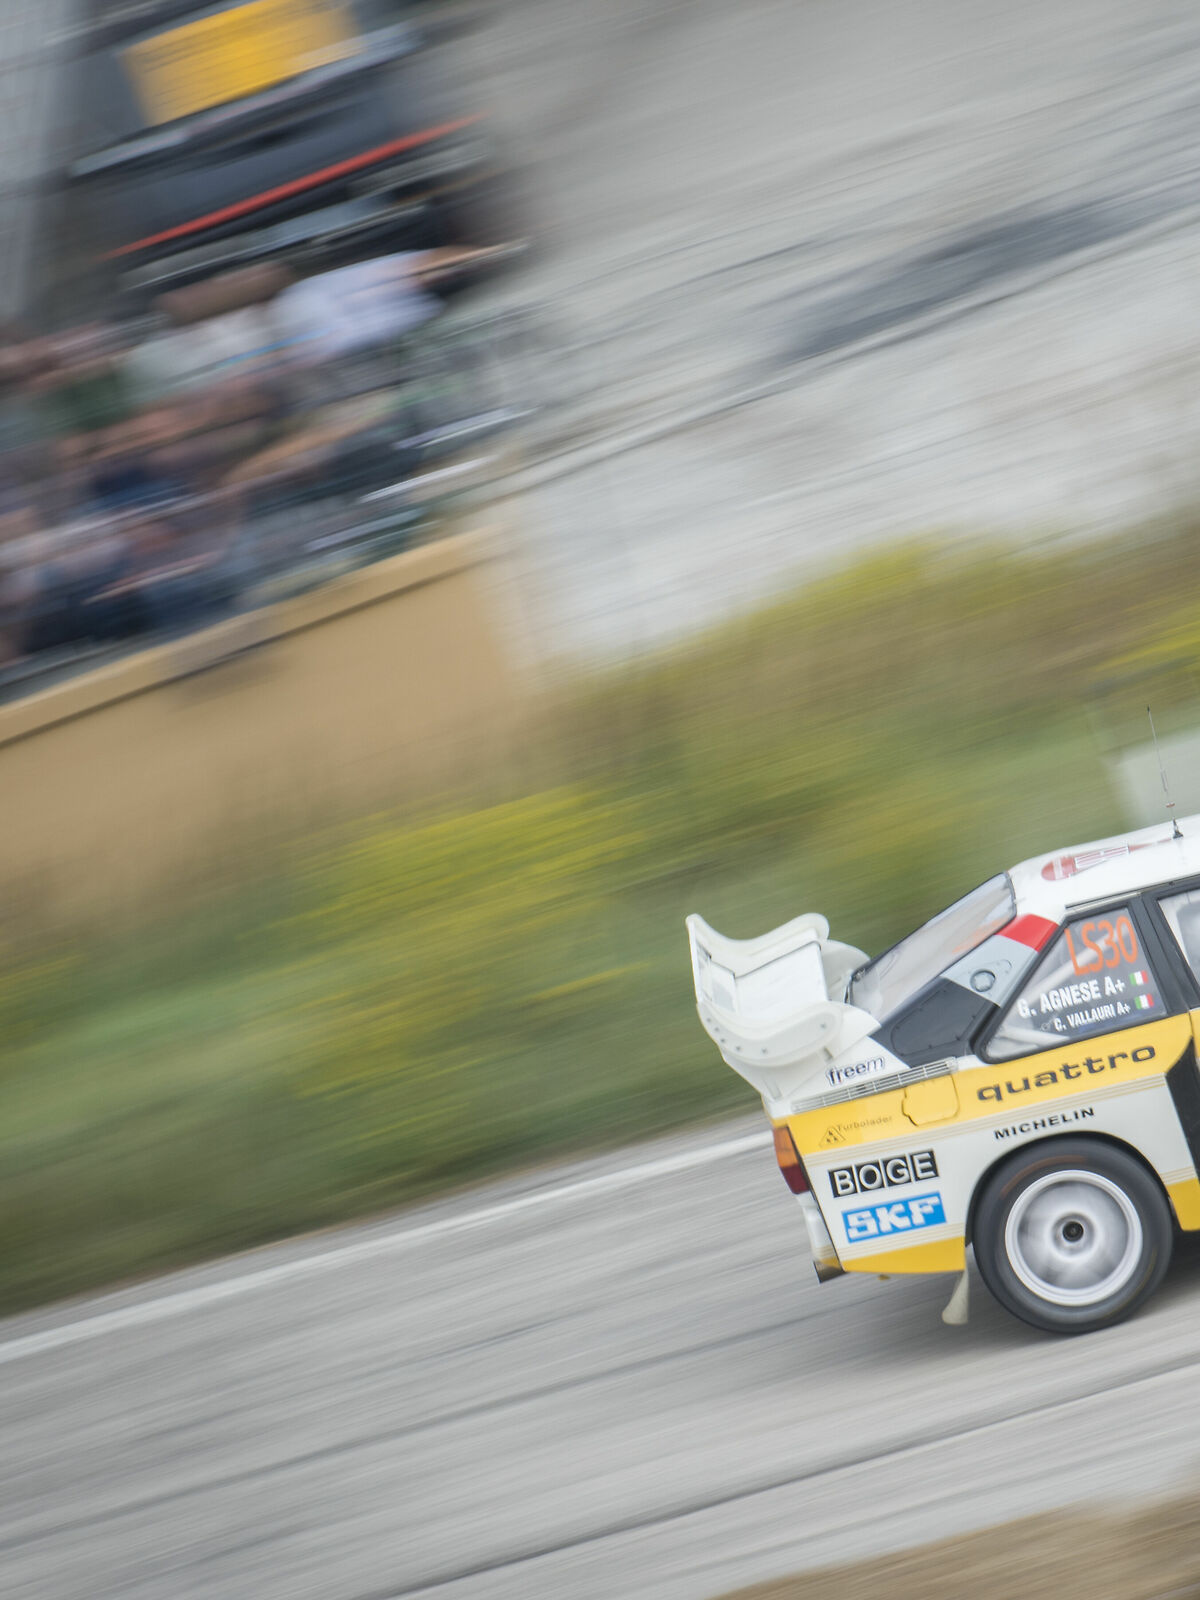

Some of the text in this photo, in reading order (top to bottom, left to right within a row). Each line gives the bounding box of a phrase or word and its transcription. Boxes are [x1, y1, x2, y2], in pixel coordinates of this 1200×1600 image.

[1064, 916, 1138, 976] LS30
[1017, 976, 1125, 1019] G. AGNESE A+
[1066, 1003, 1116, 1028] VALLAURI
[1117, 1001, 1131, 1015] A+
[828, 1057, 884, 1085] freem
[976, 1045, 1156, 1101] quattro
[994, 1107, 1095, 1140] MICHELIN
[831, 1152, 938, 1196] BOGE
[847, 1198, 941, 1239] SKF
